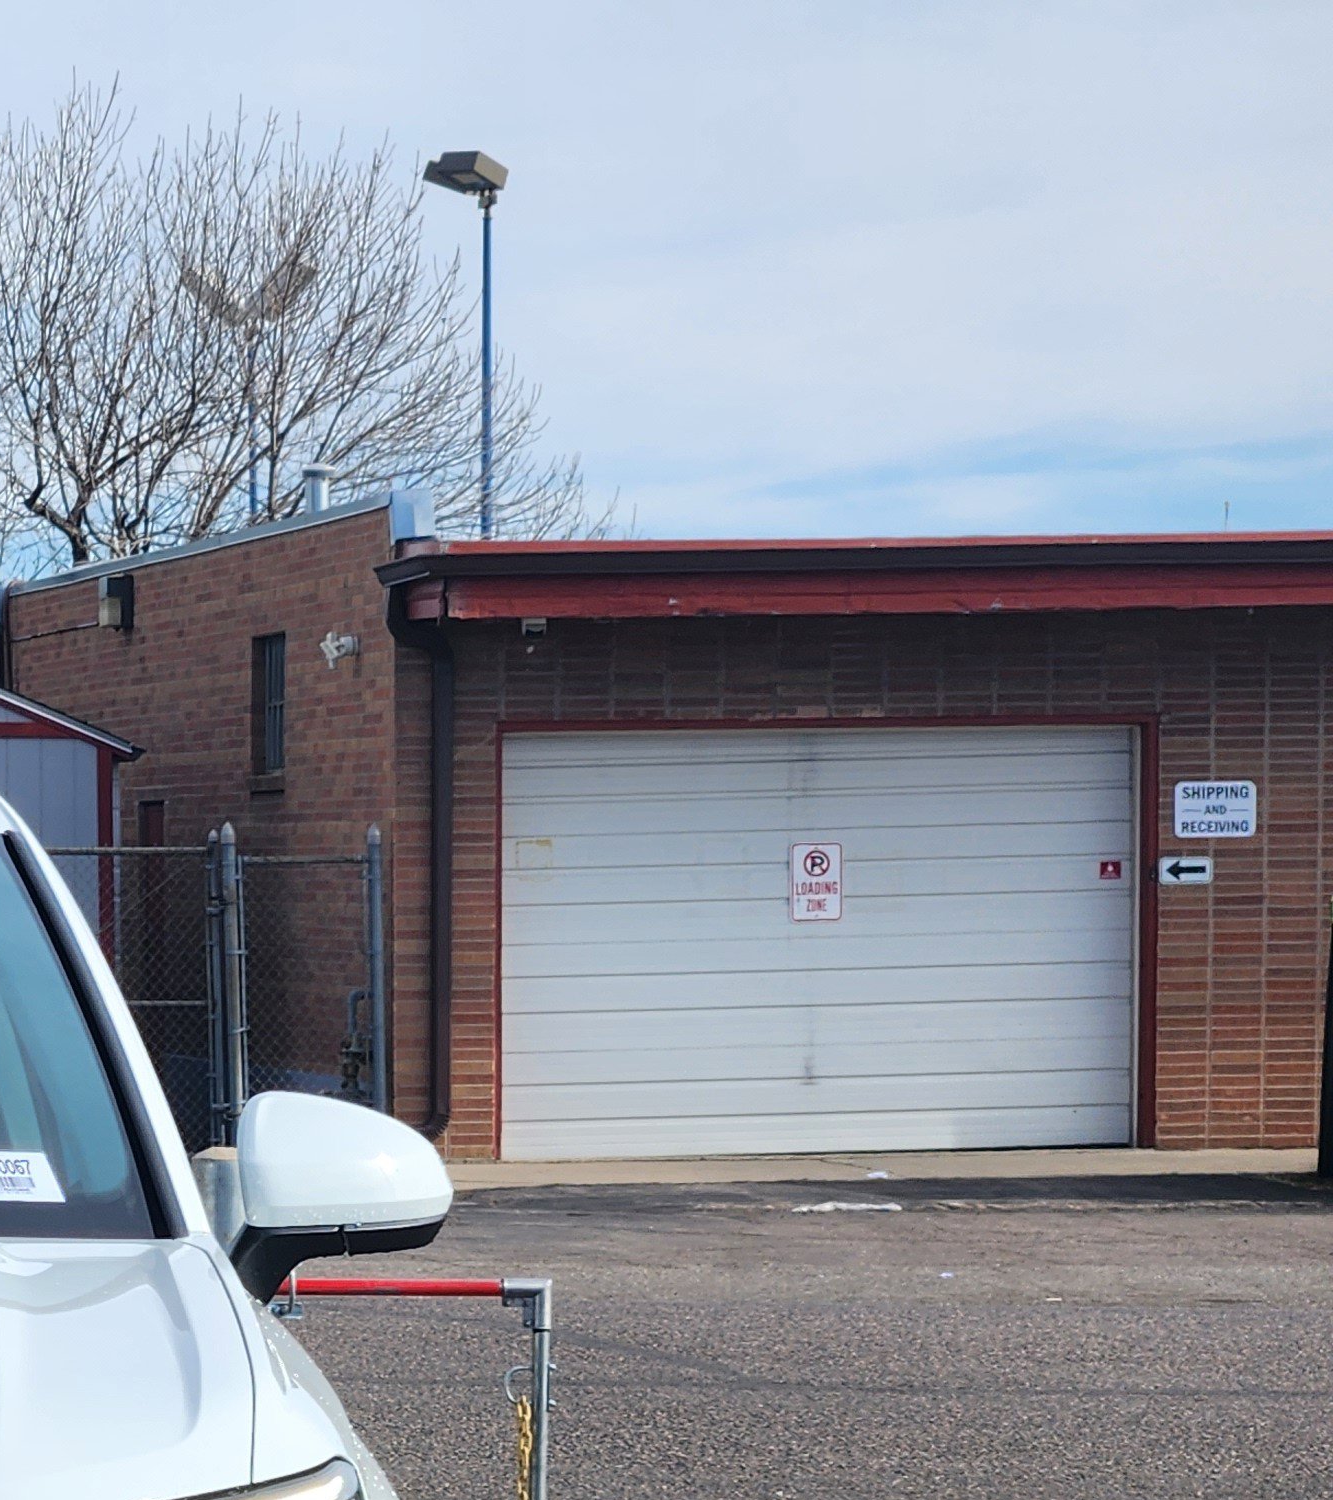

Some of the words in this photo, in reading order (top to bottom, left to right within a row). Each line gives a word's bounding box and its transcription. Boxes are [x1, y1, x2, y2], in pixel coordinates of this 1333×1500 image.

[1181, 786, 1250, 799] SHIPPING
[1203, 804, 1228, 816] AND
[1181, 820, 1250, 833] RECEIVING
[794, 881, 839, 895] LOADING
[805, 898, 828, 912] ZONE
